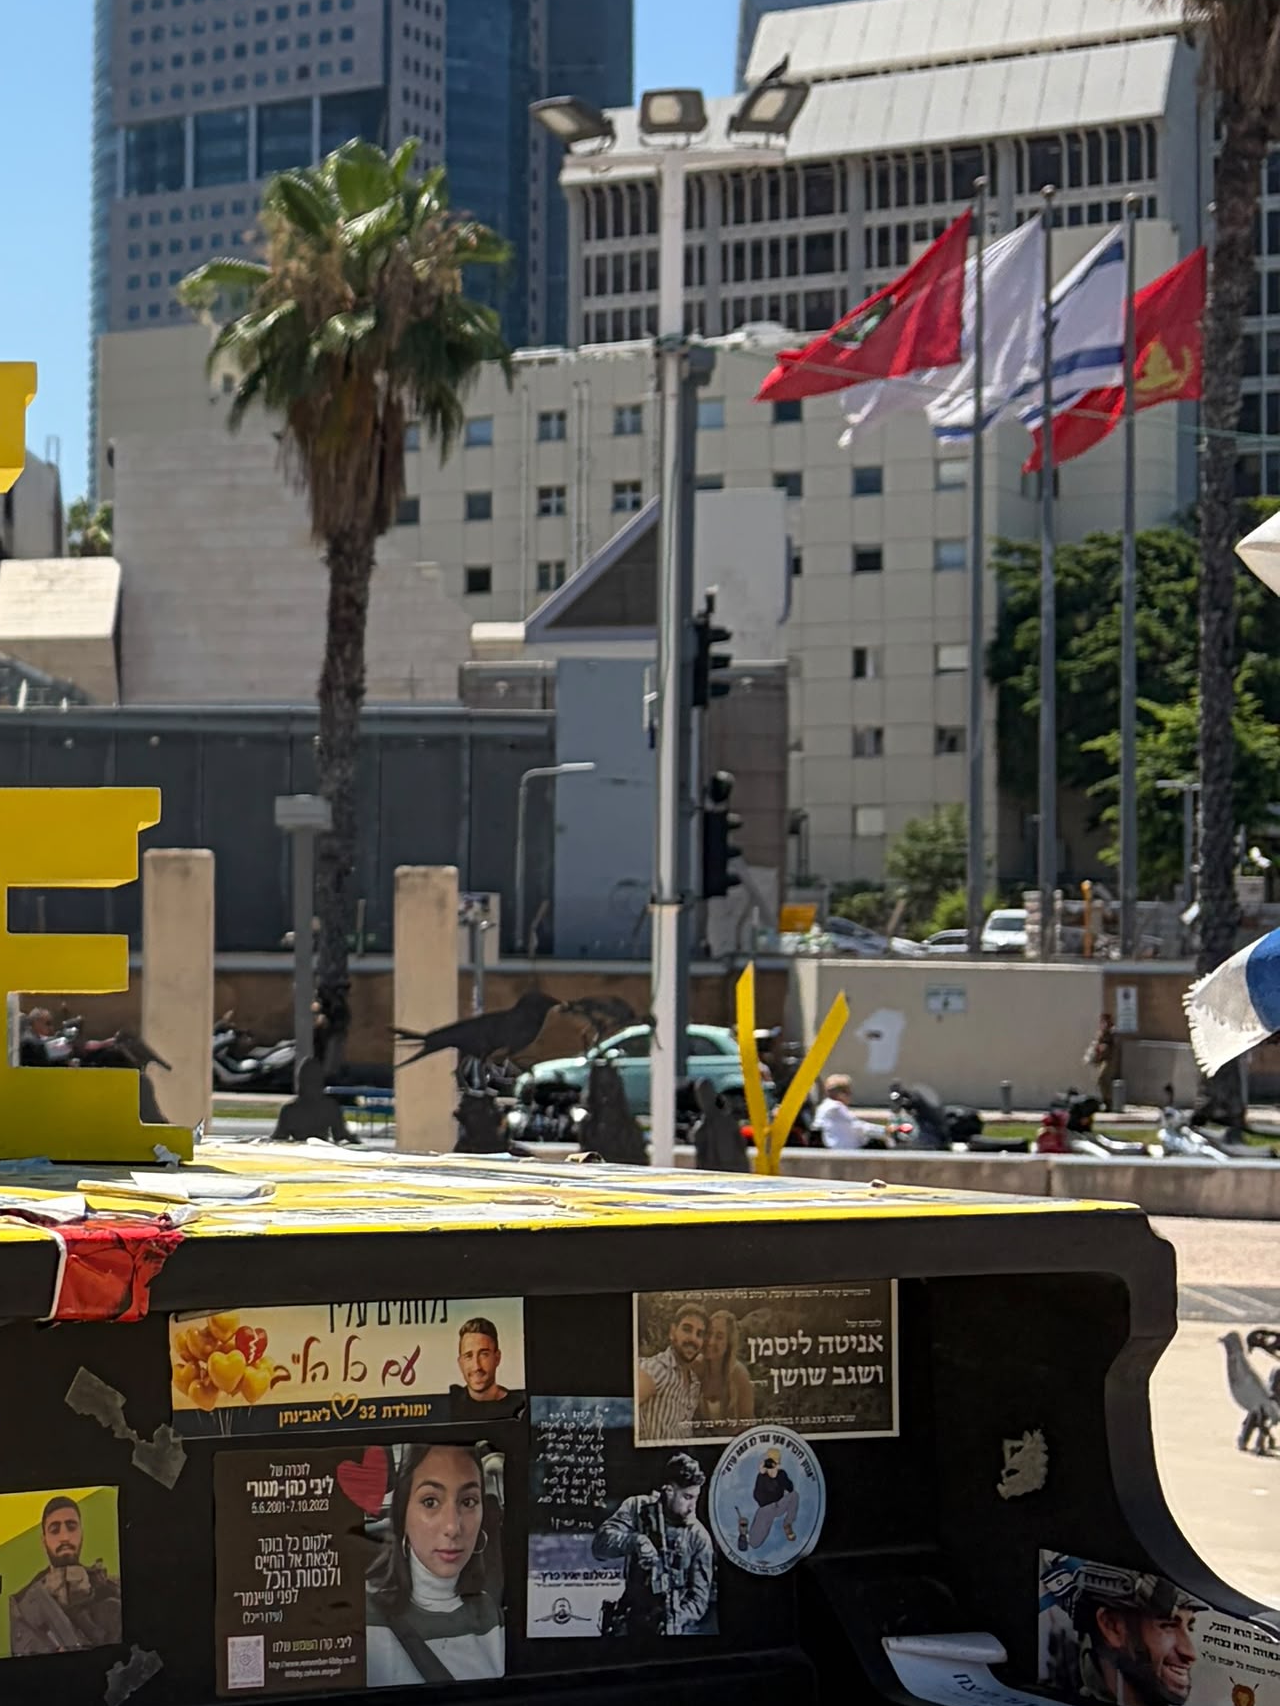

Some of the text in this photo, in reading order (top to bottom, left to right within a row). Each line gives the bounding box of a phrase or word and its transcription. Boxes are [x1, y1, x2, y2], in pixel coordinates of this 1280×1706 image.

[343, 1335, 368, 1383] כל
[747, 1329, 884, 1364] אניטה ליסמן
[381, 1345, 421, 1386] עם
[770, 1365, 884, 1394] ושגב שושן
[358, 1406, 377, 1420] 32
[382, 1404, 432, 1421] יומולדת
